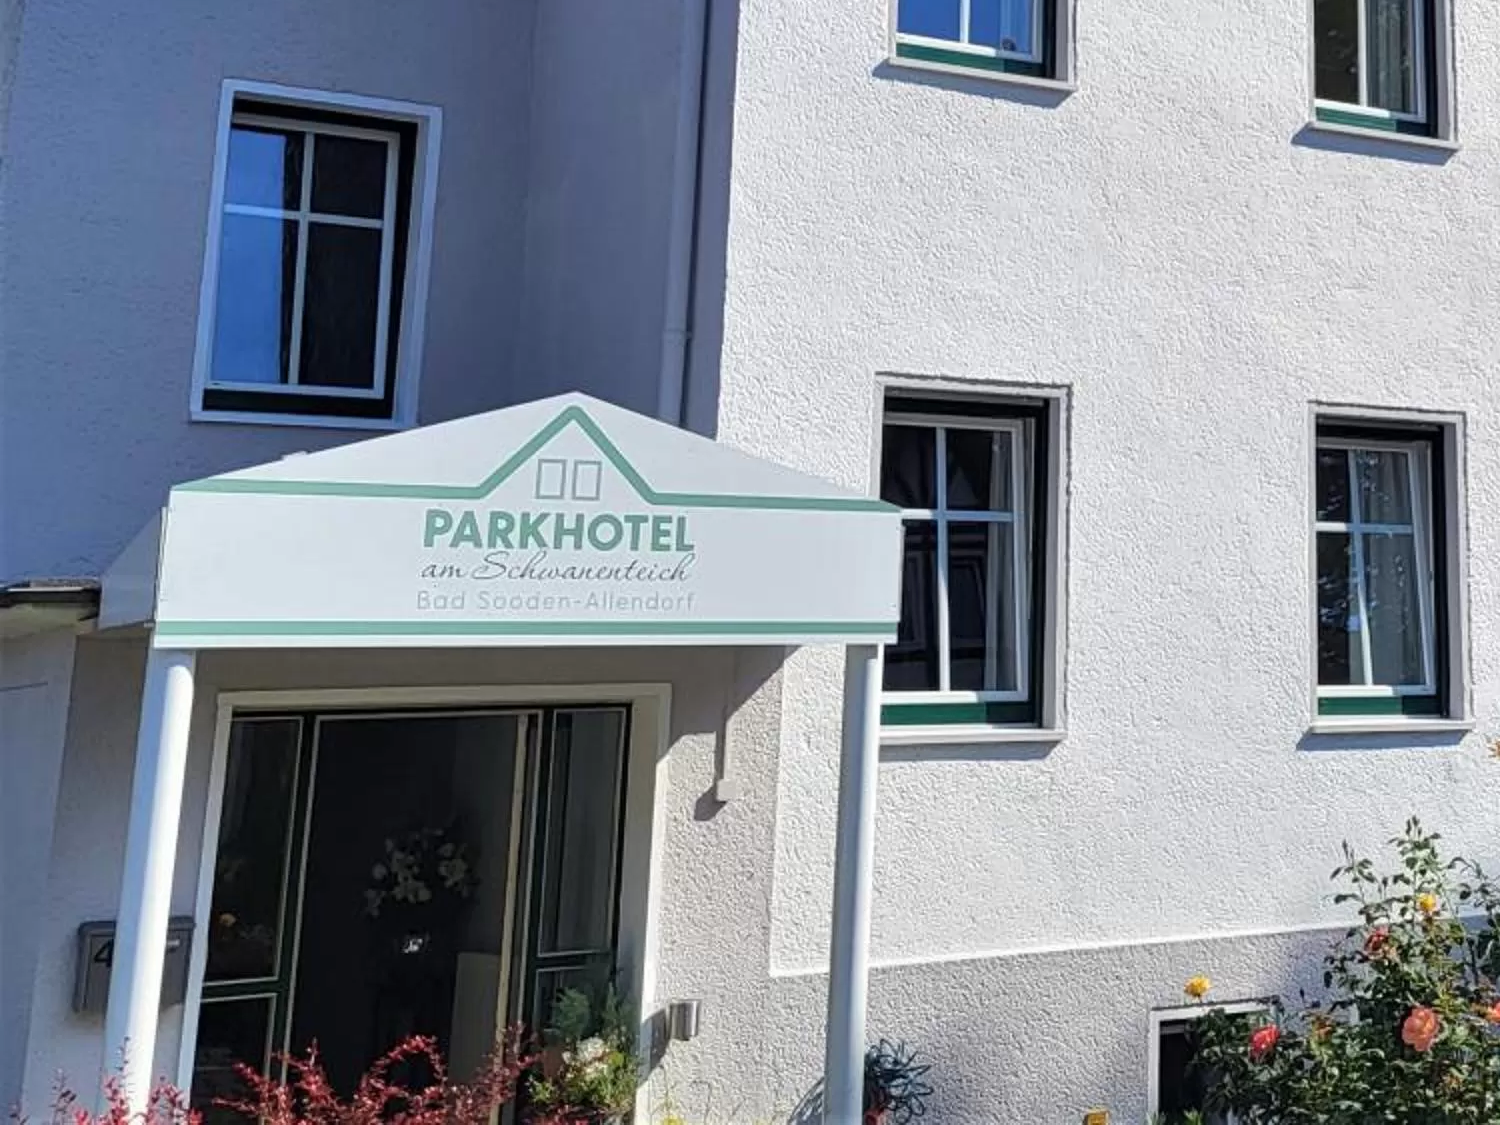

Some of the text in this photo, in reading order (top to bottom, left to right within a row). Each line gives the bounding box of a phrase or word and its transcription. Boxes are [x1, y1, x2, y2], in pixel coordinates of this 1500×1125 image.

[423, 509, 695, 552] PARKHOTEL
[421, 550, 696, 581] am Schwanenteich
[417, 590, 695, 611] Bad Sooden-Allendorf
